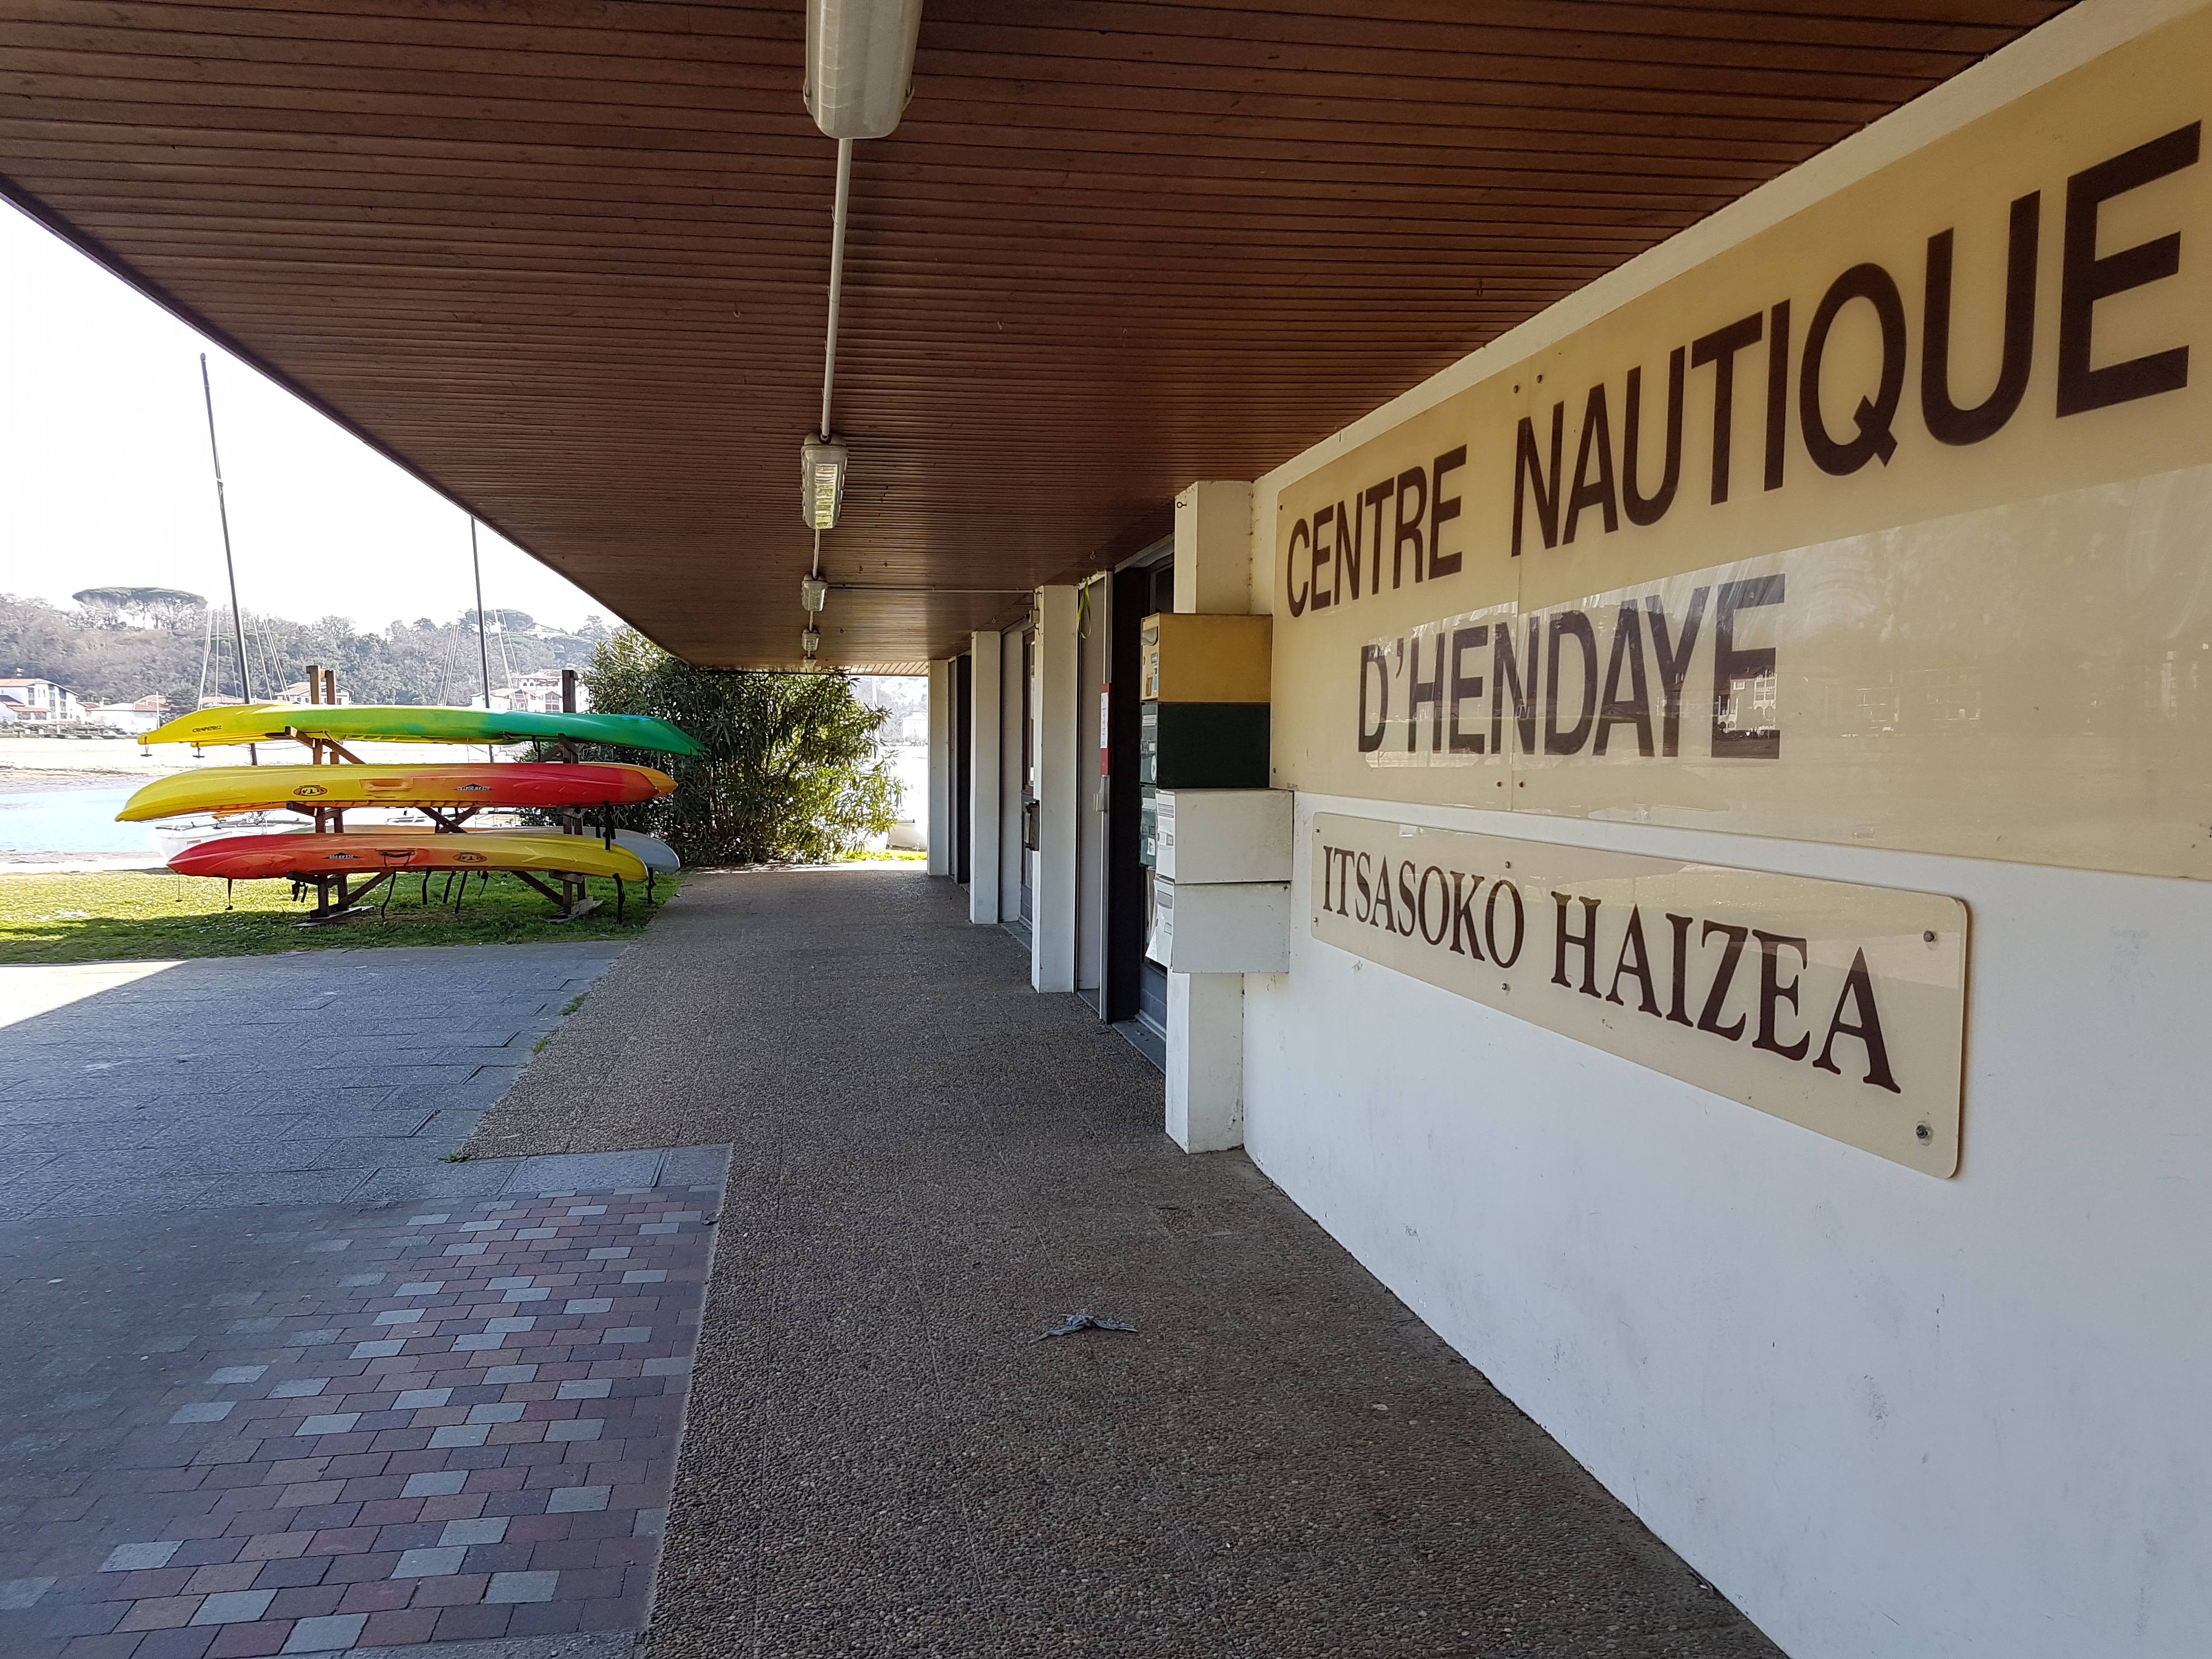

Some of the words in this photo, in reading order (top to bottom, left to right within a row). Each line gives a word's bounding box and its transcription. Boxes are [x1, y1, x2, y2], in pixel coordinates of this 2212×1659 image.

[1286, 443, 1467, 618] CENTRE
[1510, 119, 2202, 556] NAUTIQUE
[1357, 573, 1786, 759] D'HENDAYE
[1321, 844, 1525, 969] ITSASOKO
[1550, 890, 1903, 1094] HAIZEA
